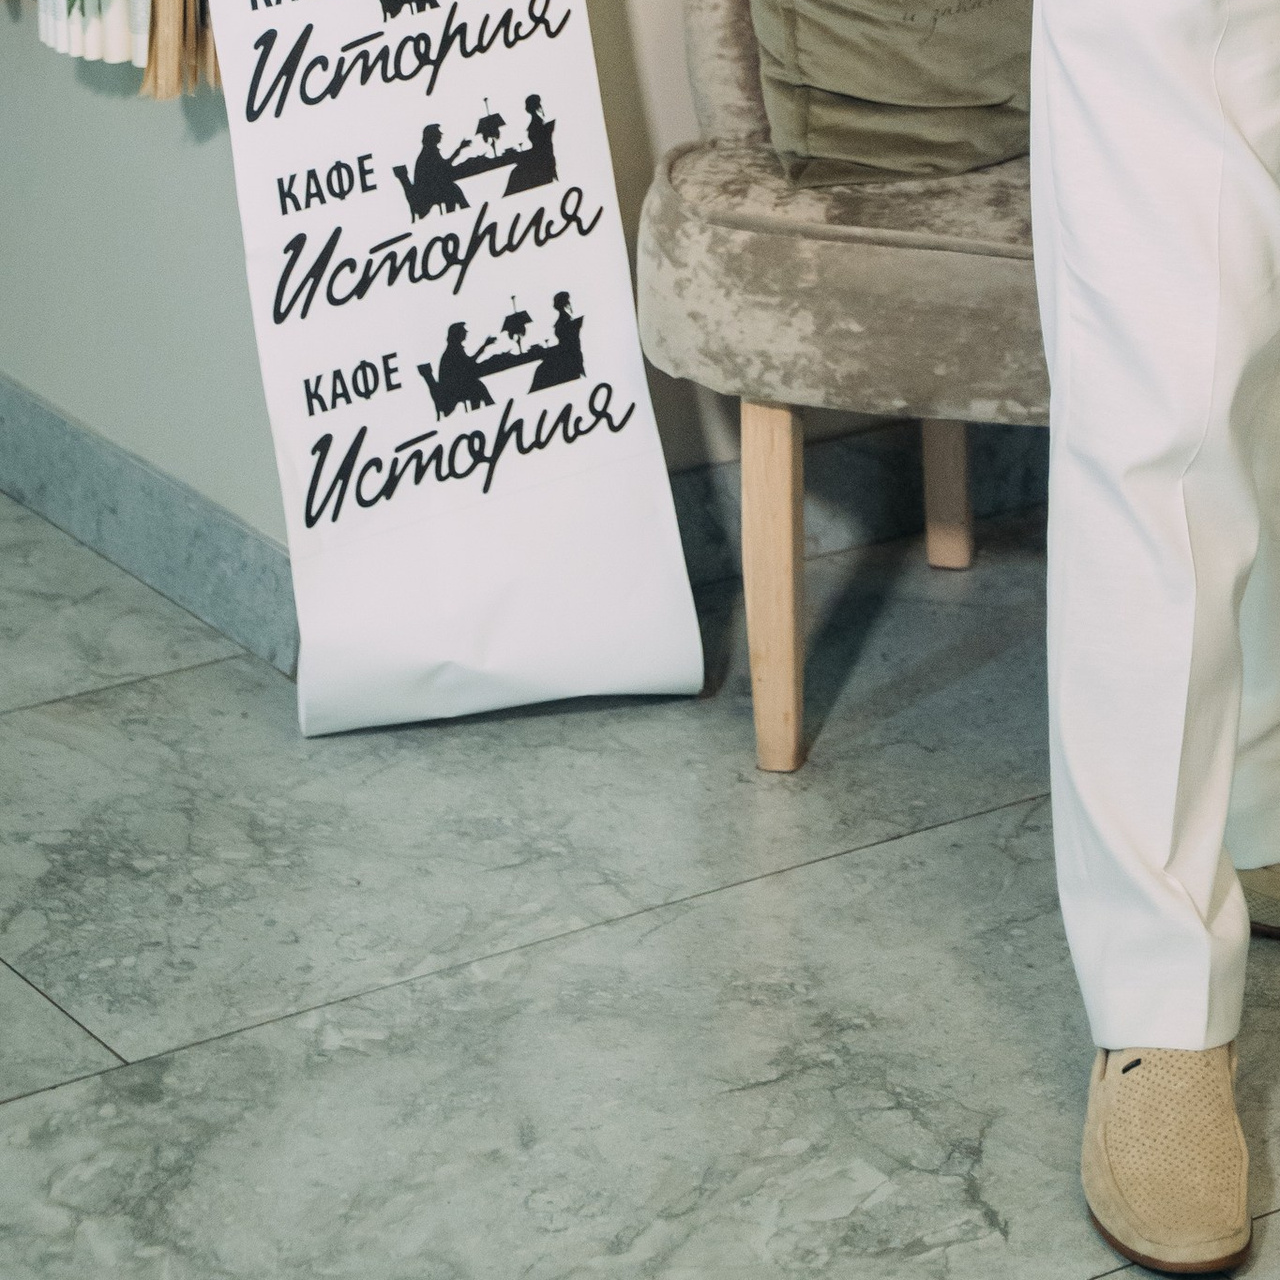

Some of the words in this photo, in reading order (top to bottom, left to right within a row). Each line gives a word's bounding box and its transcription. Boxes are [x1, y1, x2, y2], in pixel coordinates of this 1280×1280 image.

[276, 152, 378, 217] КАФЕ
[272, 186, 604, 325] История
[303, 350, 402, 418] КАФЕ
[304, 382, 636, 529] История
